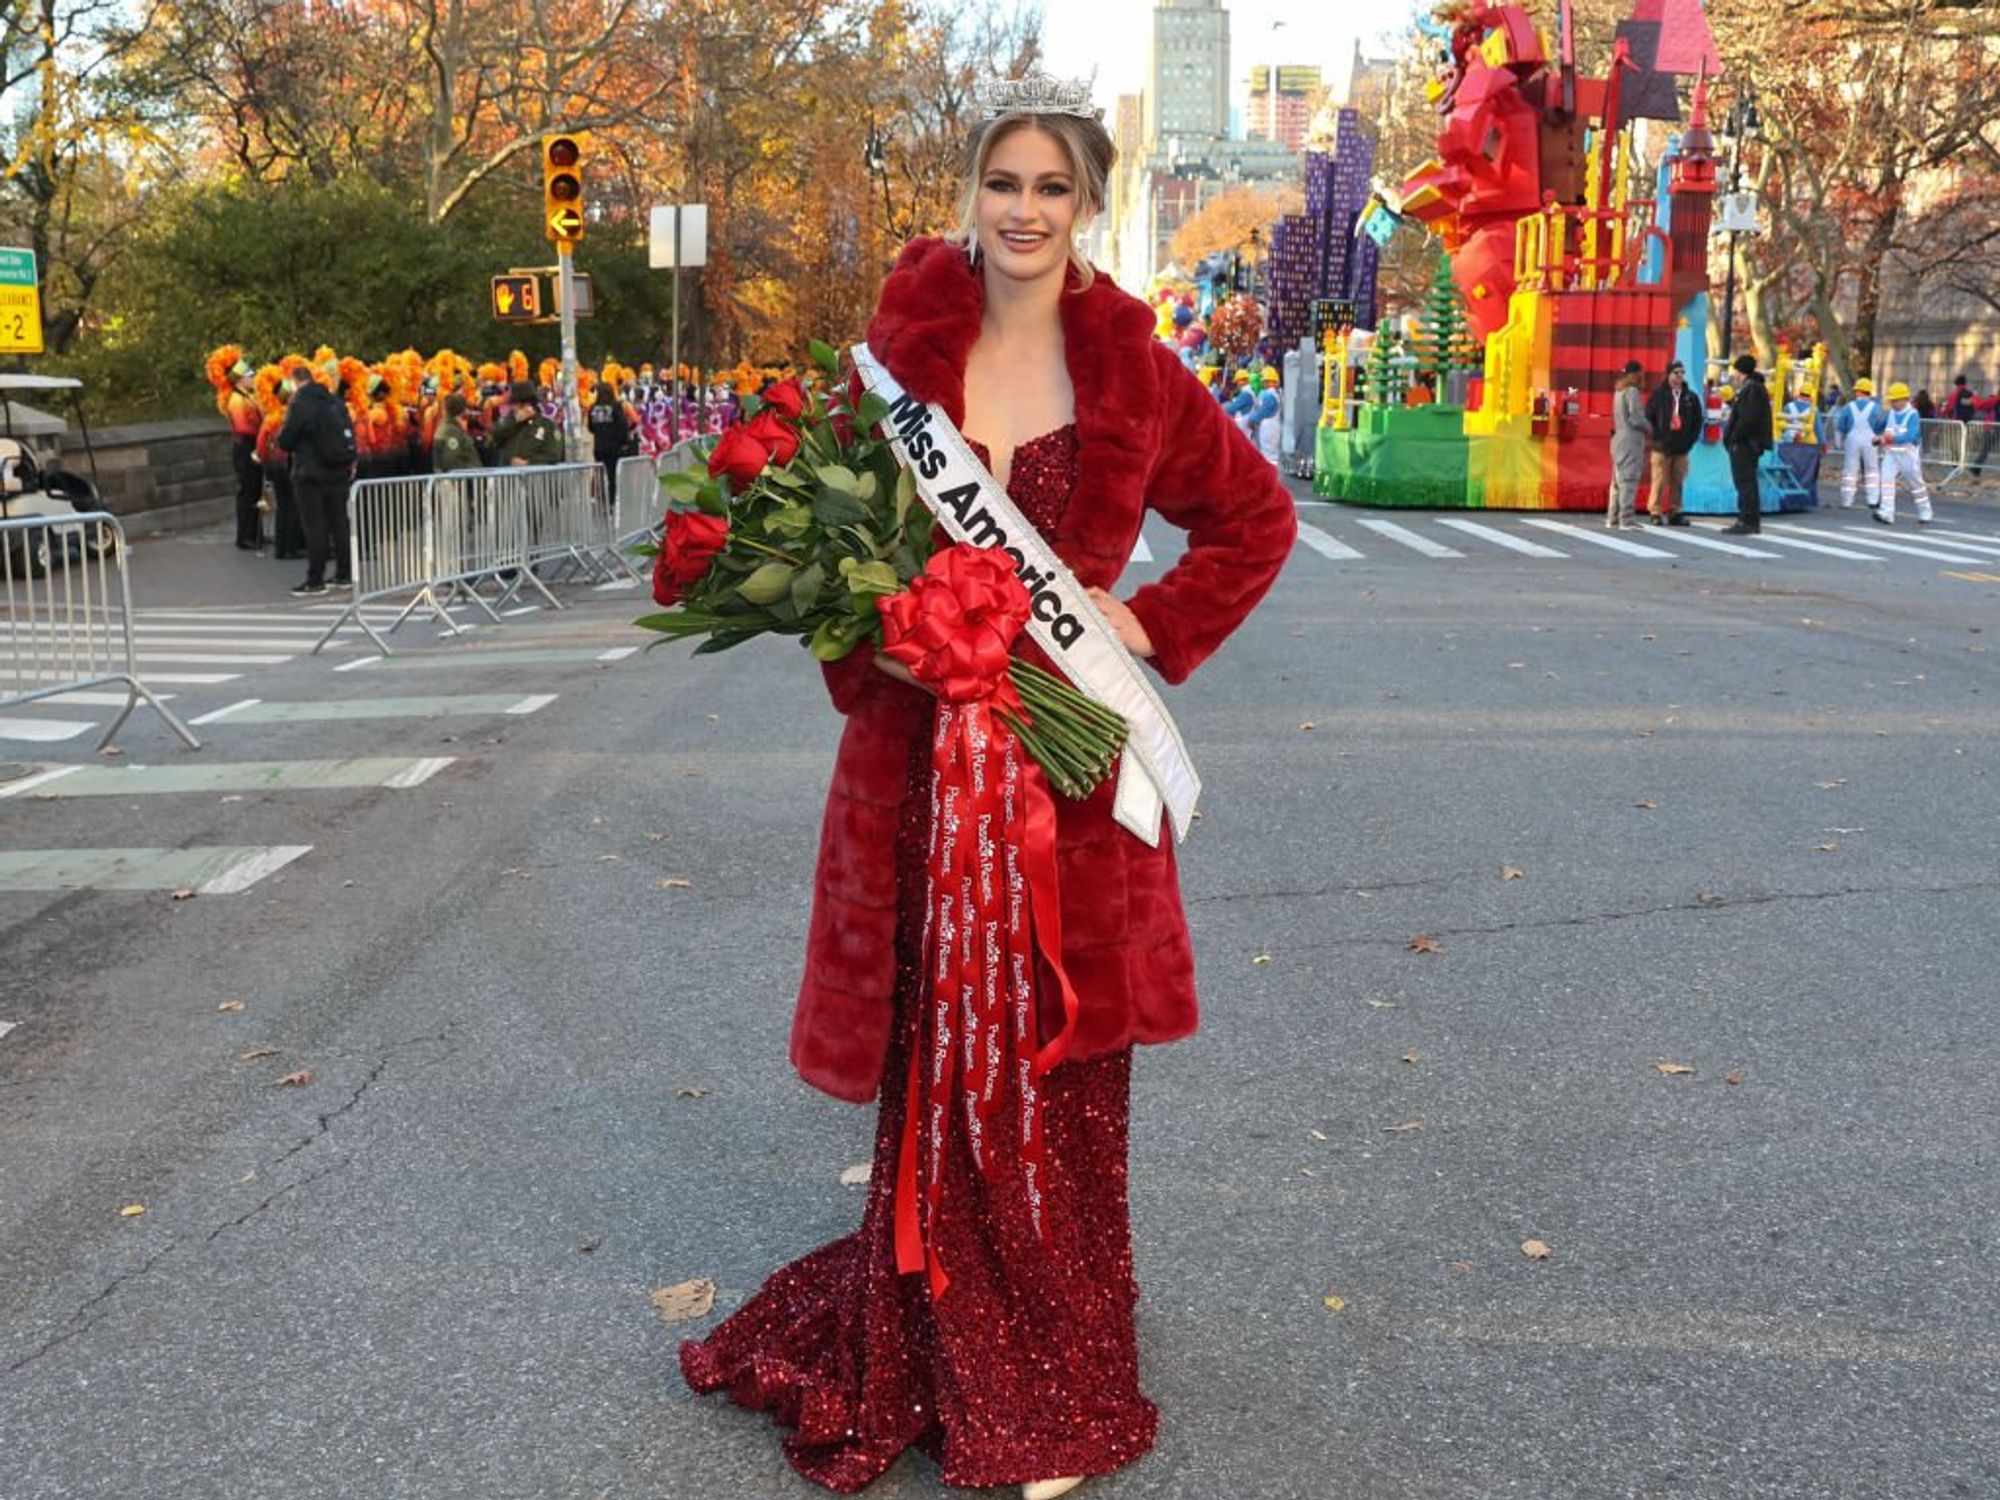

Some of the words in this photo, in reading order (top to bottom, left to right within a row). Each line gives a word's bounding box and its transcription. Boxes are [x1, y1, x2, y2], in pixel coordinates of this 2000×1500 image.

[521, 283, 533, 311] 6
[889, 392, 948, 481] Miss
[967, 703, 988, 753] Passion
[973, 754, 988, 796] Roses
[1004, 734, 1019, 783] Passion
[944, 785, 960, 834] Passion
[1004, 784, 1016, 824] Roses
[942, 835, 956, 877] Roses
[979, 813, 995, 862] Passion
[981, 863, 994, 905] Roses
[1007, 844, 1024, 893] Passion
[940, 894, 956, 942] Passion
[1010, 894, 1023, 935] Roses
[938, 943, 952, 982] Roses
[986, 921, 1001, 968] Passion
[987, 968, 998, 1010] Roses
[1013, 953, 1030, 1000] Passion
[937, 1000, 951, 1046] Passion
[1016, 1001, 1029, 1042] Roses
[933, 1047, 947, 1086] Roses
